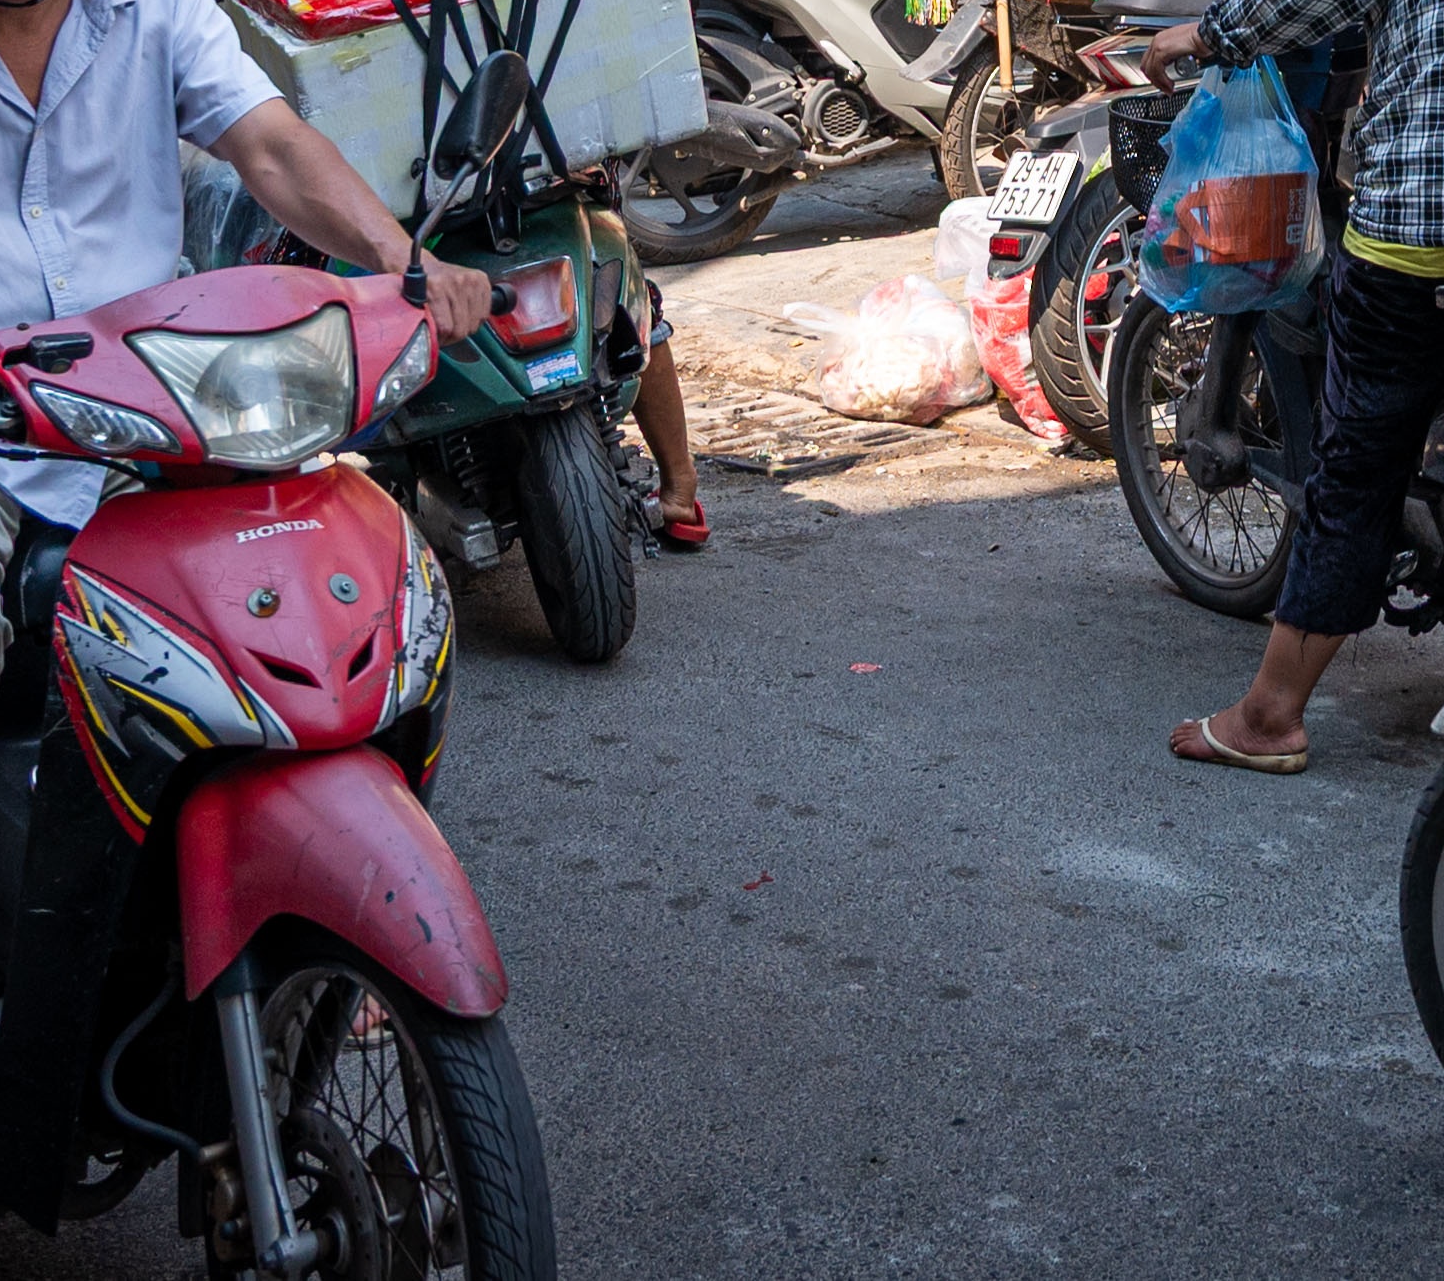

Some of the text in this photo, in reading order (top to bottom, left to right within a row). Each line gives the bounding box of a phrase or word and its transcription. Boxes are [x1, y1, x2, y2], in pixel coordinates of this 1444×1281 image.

[1011, 155, 1066, 184] 29-AH
[993, 187, 1057, 218] 753.71
[236, 519, 325, 544] HONDA
